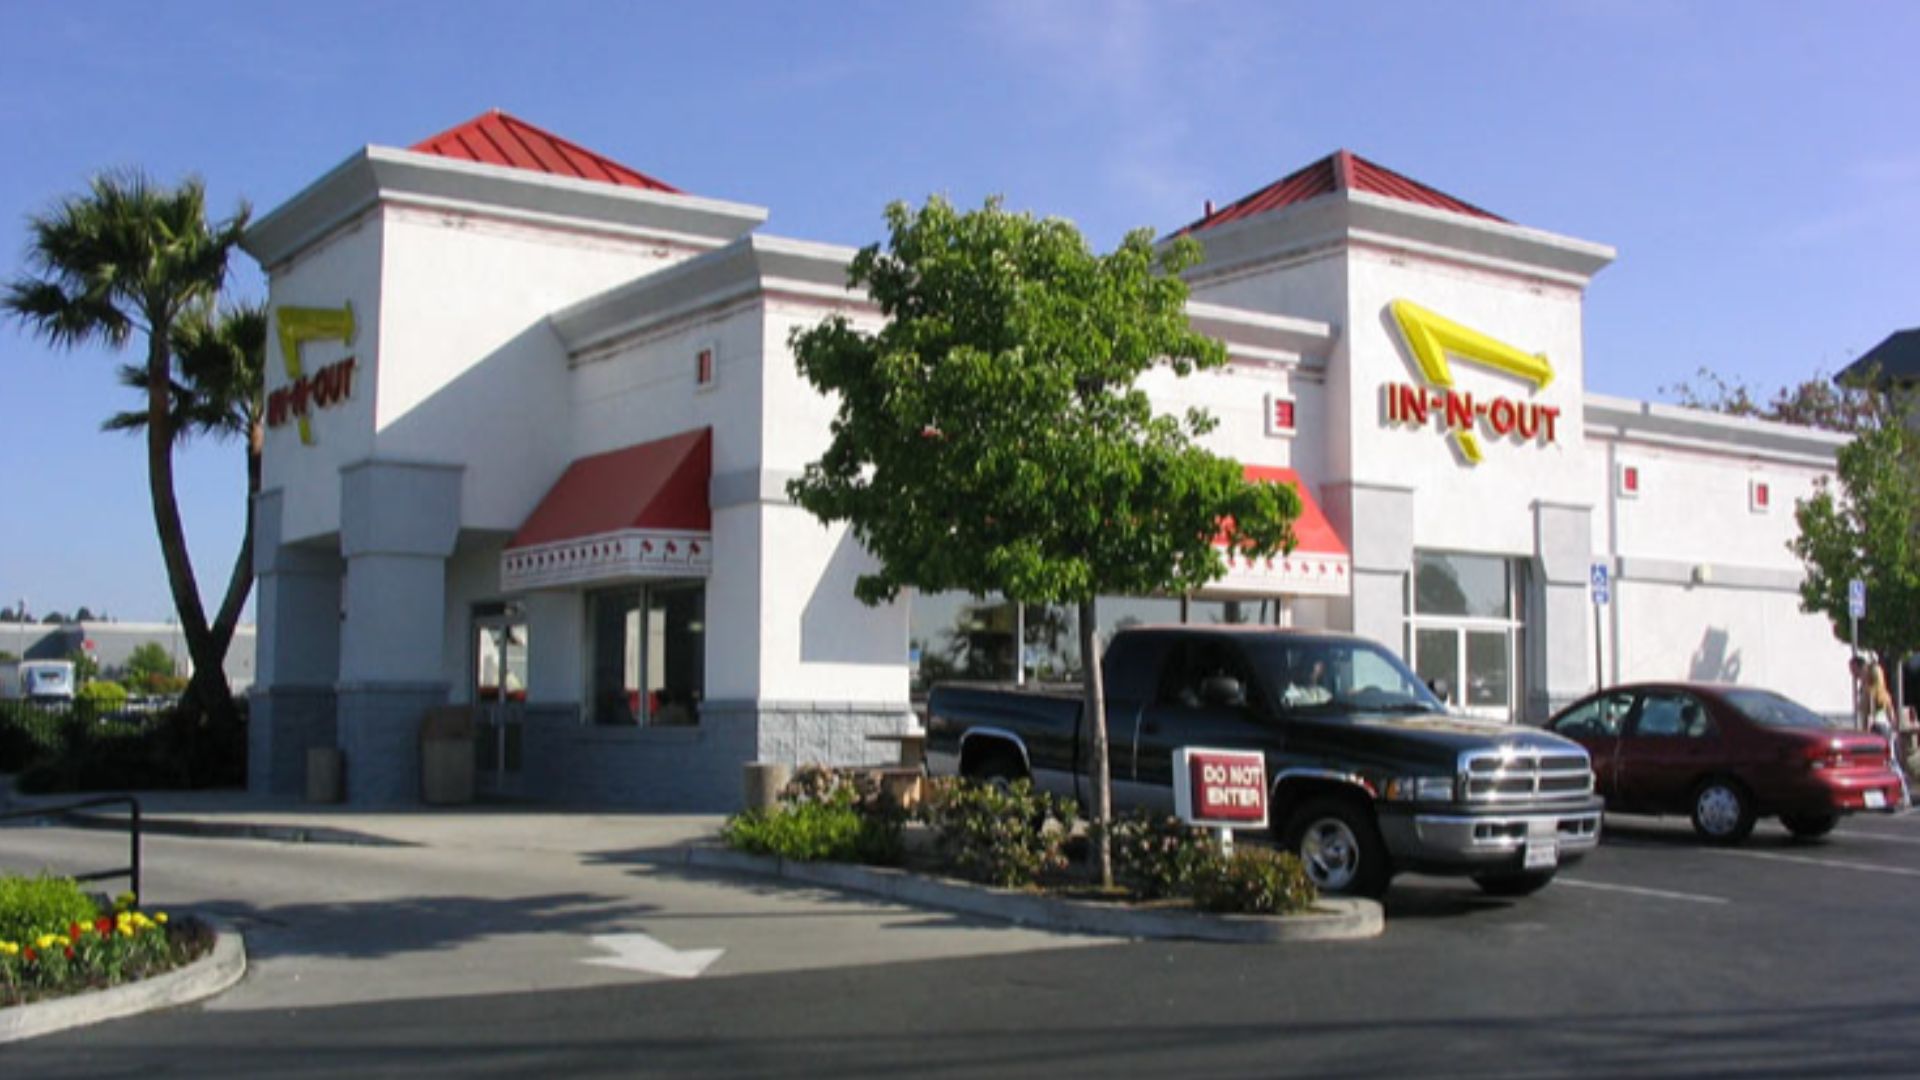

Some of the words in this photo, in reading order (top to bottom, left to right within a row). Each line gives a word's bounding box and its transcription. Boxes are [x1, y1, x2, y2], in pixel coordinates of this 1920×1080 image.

[1388, 383, 1559, 442] IN-N-OUT
[1203, 764, 1226, 783] DO
[1230, 765, 1260, 785] NOT
[1207, 786, 1259, 806] ENTER
